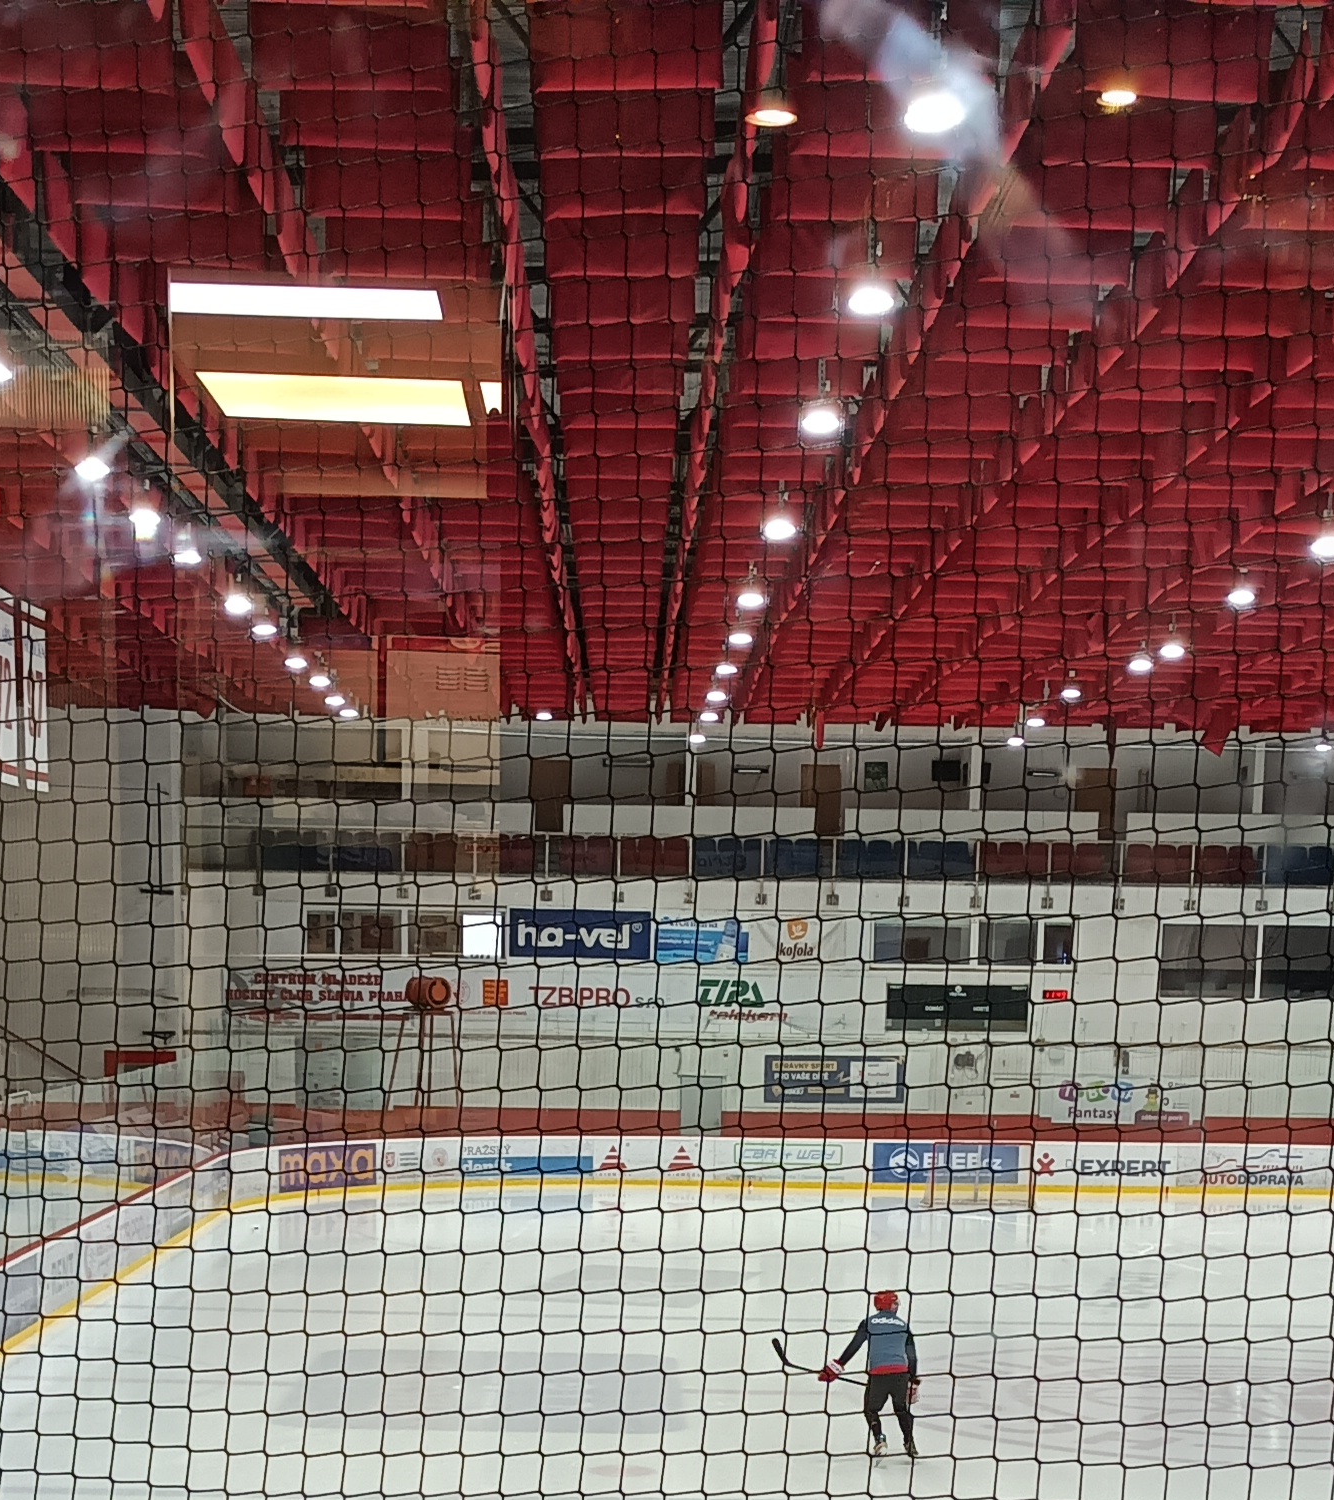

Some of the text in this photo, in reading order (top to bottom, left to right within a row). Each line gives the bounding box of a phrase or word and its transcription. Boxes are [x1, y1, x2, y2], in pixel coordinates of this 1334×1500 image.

[517, 918, 630, 950] ha-vel
[779, 943, 814, 960] kofola
[253, 973, 318, 986] CENTRUM
[280, 988, 314, 1002] CLUB
[1067, 1106, 1121, 1120] Fantasy
[280, 1148, 375, 1187] maxa
[1080, 1159, 1171, 1178] EXPERT
[1199, 1173, 1305, 1187] AUTODOPRAVA
[870, 1316, 905, 1327] adidas
